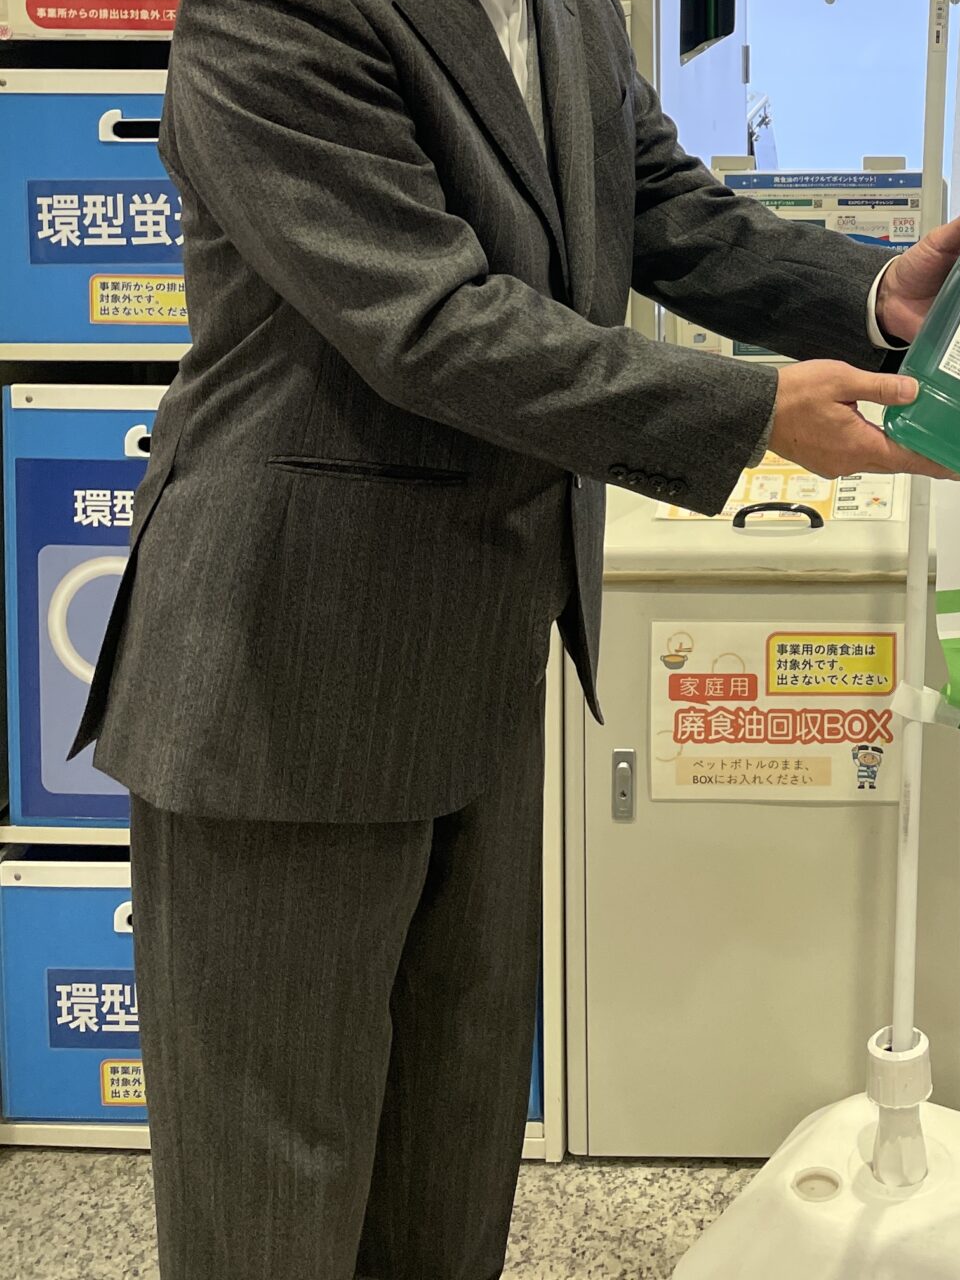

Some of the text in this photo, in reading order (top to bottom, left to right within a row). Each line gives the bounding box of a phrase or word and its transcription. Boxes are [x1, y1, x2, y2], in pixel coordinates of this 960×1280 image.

[100, 294, 160, 305] 対象外です。
[777, 643, 876, 656] 事業用の廃食油は
[777, 658, 844, 671] 対象外です。
[777, 673, 889, 686] 出さないでください
[680, 677, 749, 697] 家庭用
[676, 710, 892, 741] 廃食油回収BOX
[692, 759, 811, 771] ペットボトルのまま、
[692, 774, 813, 785] BOXにお入れください
[56, 983, 140, 1033] 環型
